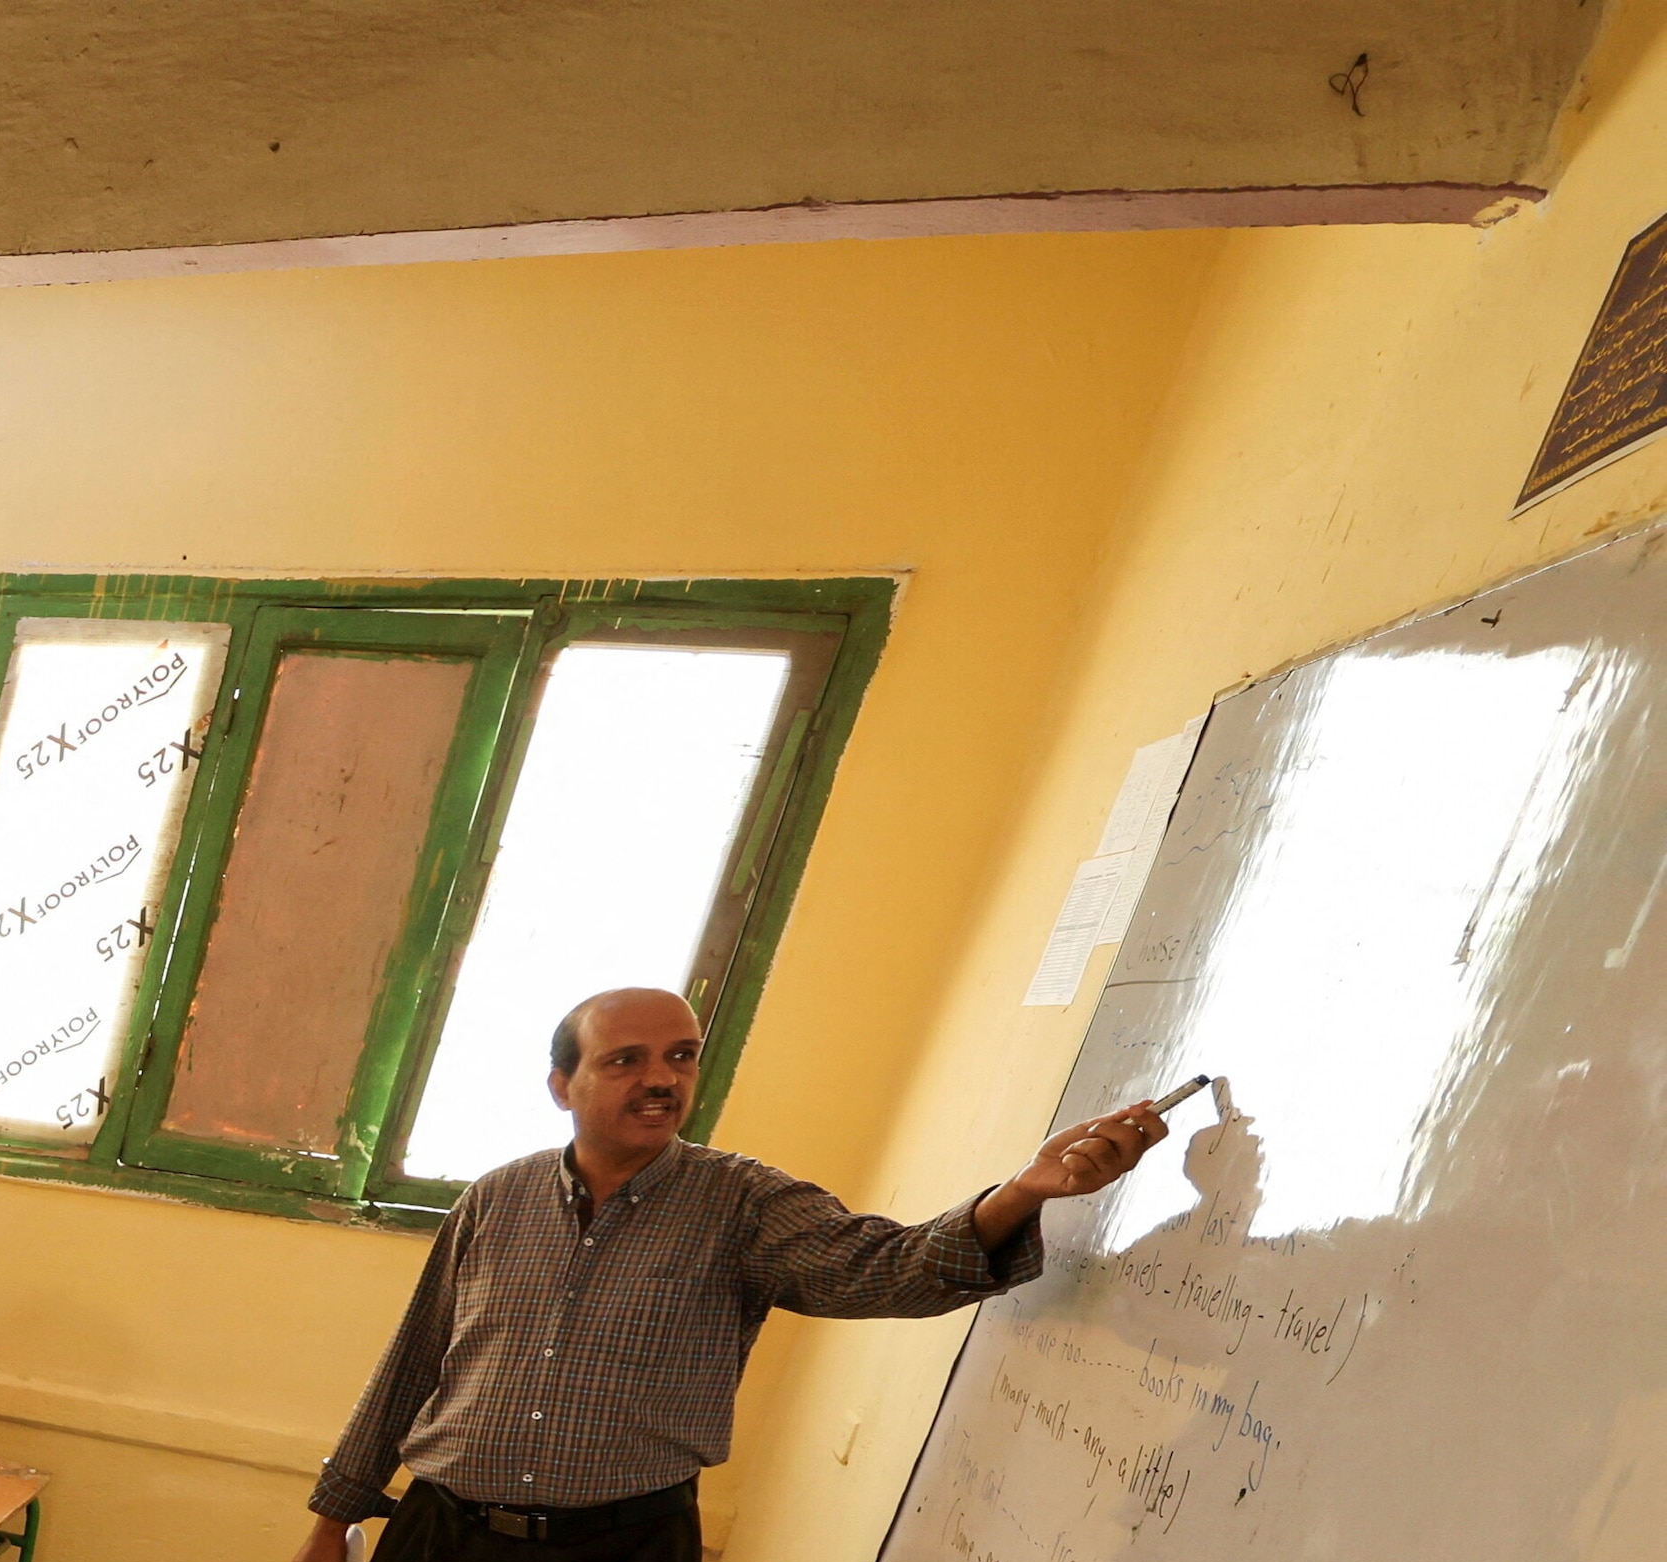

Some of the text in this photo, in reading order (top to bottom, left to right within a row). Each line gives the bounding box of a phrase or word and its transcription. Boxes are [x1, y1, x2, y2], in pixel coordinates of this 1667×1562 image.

[137, 728, 203, 788] X25
[96, 907, 154, 962] X25
[55, 1077, 110, 1129] X25
[1173, 1262, 1251, 1355] travelling
[1139, 1338, 1183, 1402] books
[1189, 1383, 1208, 1410] in
[1211, 1392, 1234, 1452] my
[1083, 1426, 1106, 1488] any
